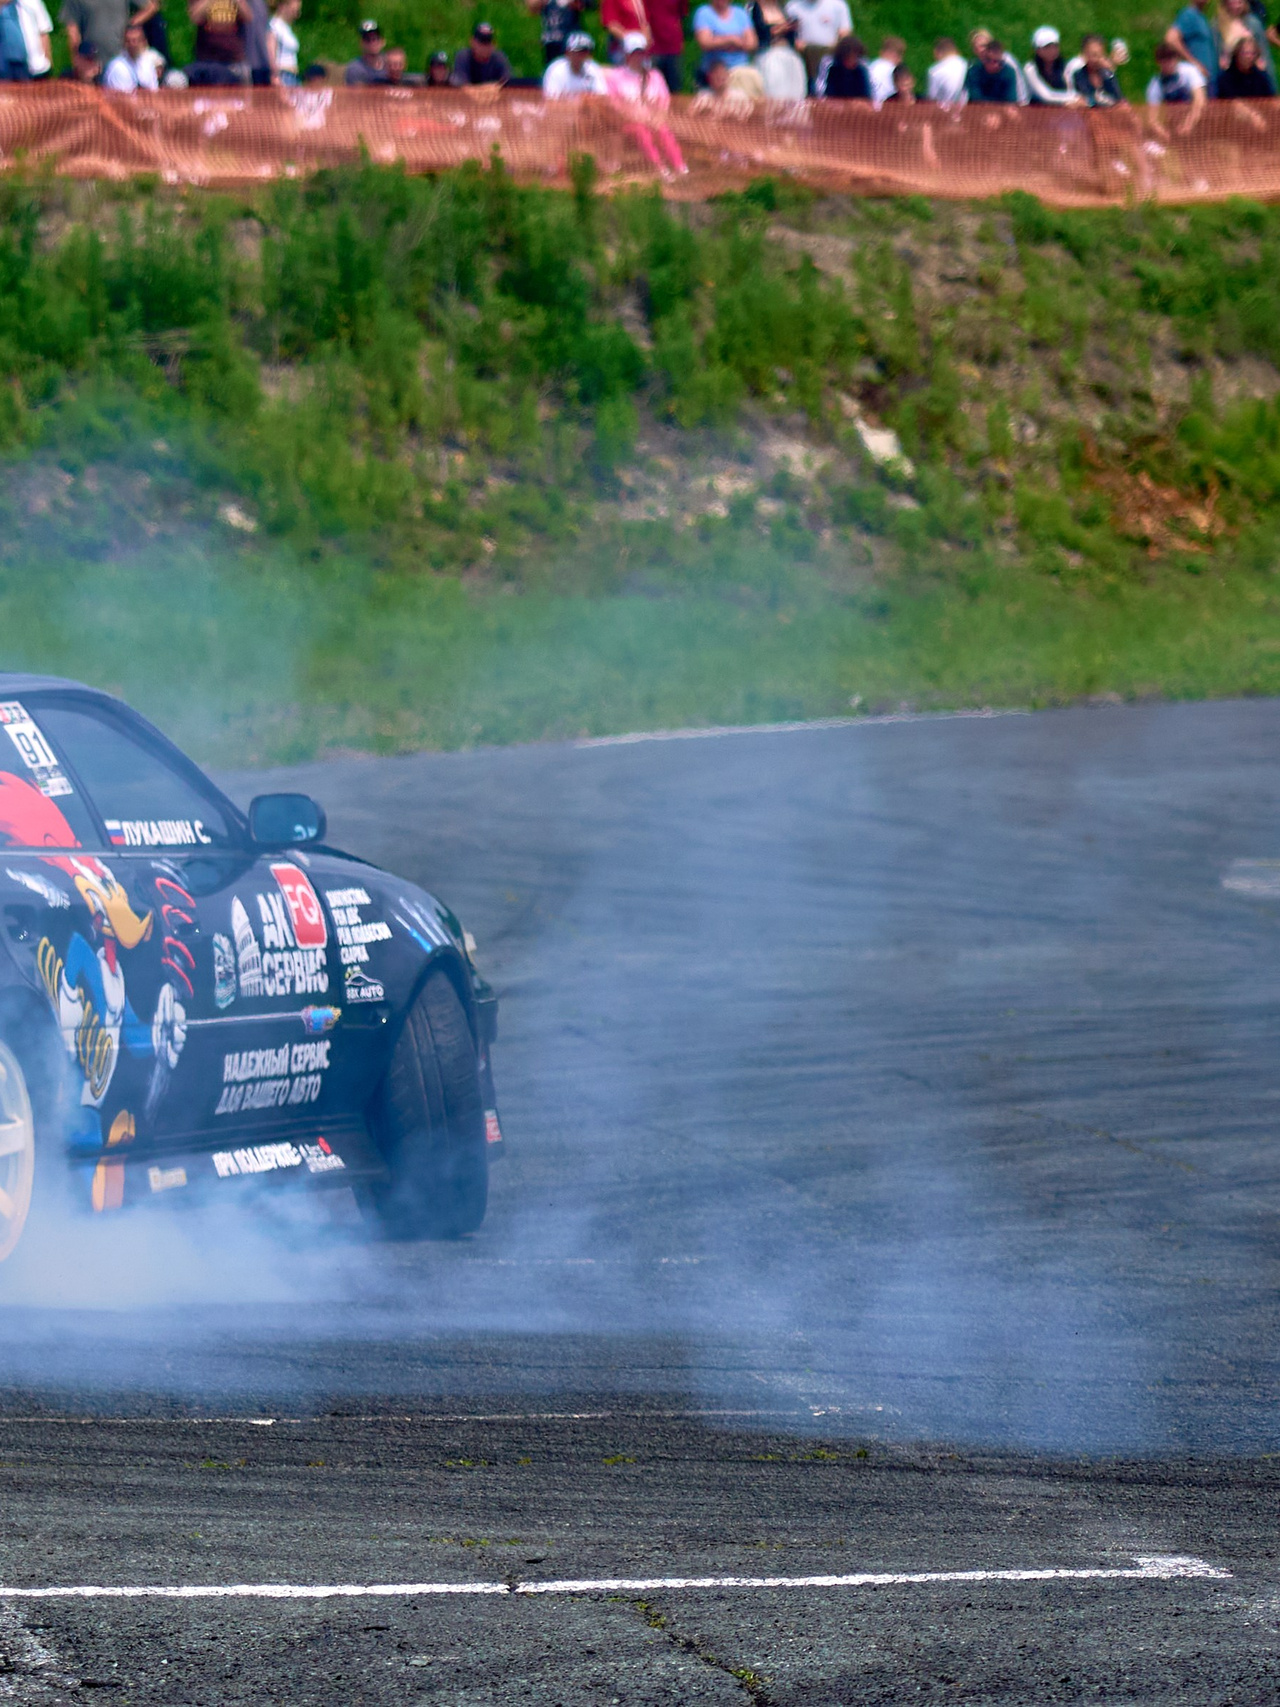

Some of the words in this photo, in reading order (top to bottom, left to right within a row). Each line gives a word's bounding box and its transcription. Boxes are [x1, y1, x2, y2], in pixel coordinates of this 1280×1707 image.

[16, 731, 51, 764] 91
[121, 820, 194, 846] ЛУКАШИН
[262, 949, 329, 996] СЕРВИС
[290, 1040, 331, 1075] СЕРВИС
